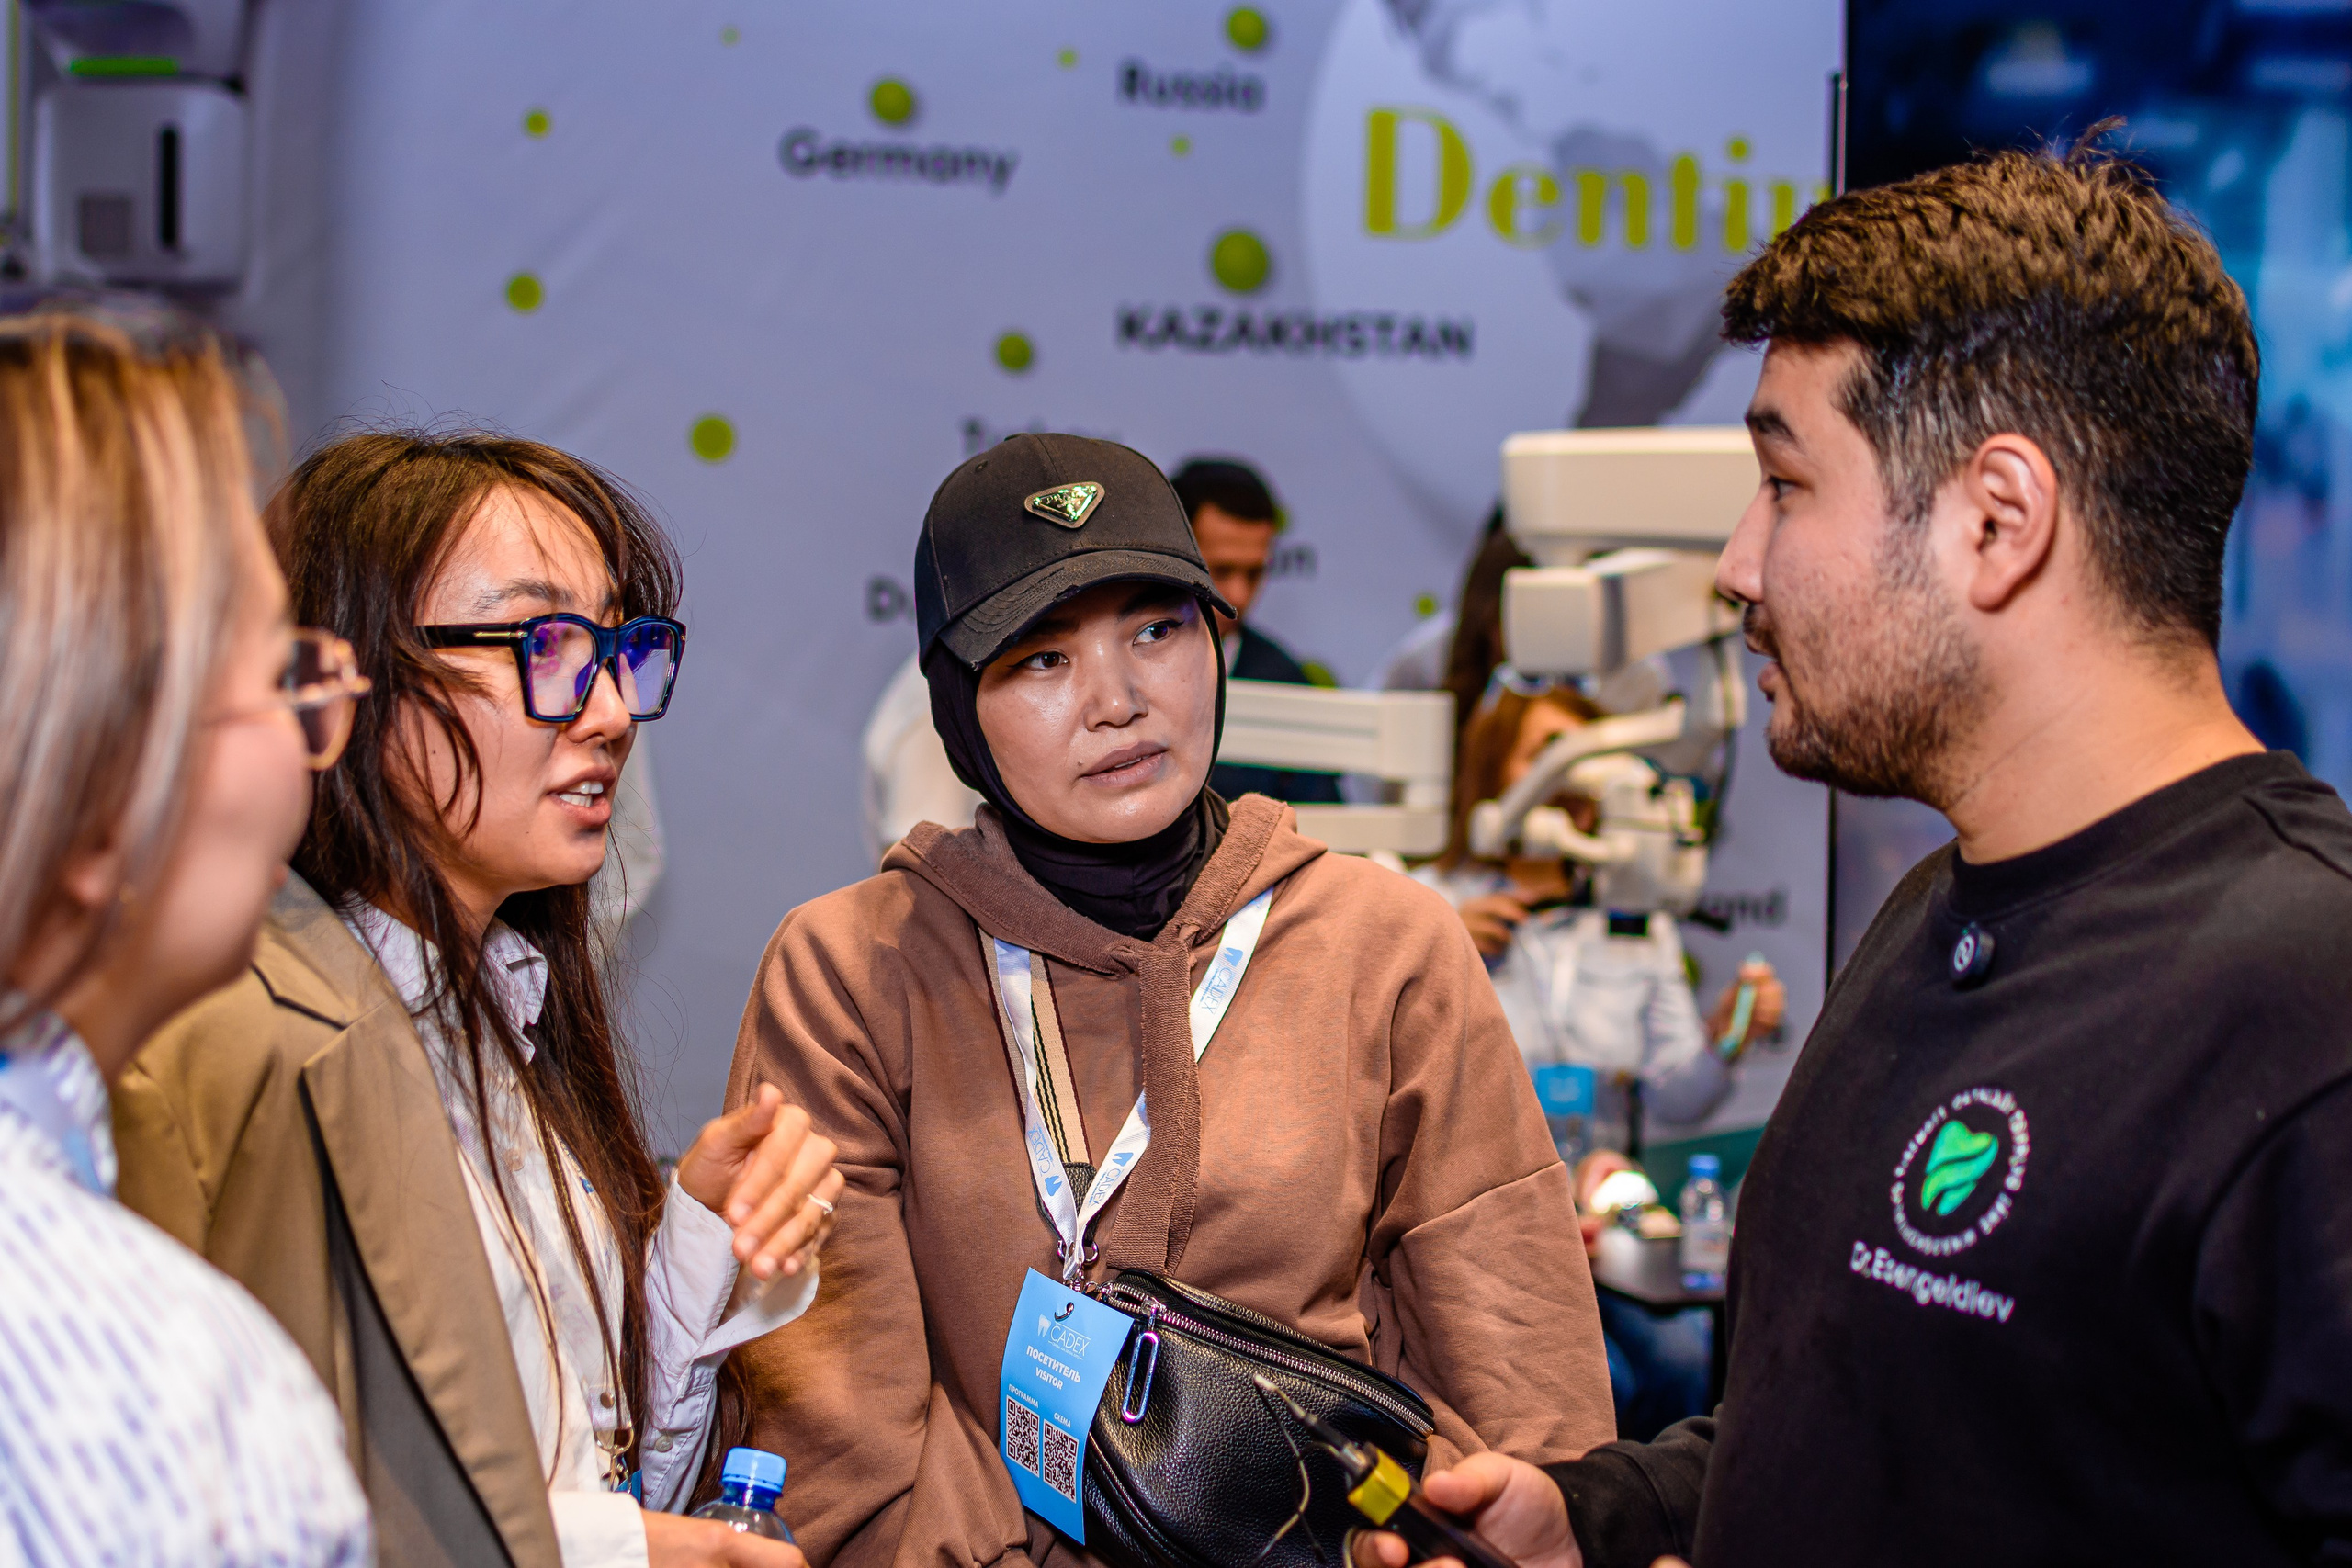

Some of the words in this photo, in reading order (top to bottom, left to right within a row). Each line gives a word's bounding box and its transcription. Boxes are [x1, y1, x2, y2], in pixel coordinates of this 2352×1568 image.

[1117, 58, 1266, 112] Russia
[779, 126, 1017, 194] Germany
[1117, 305, 1472, 359] KAZAKHSTAN
[1203, 967, 1232, 1014] CADEX
[1050, 1325, 1090, 1357] CADEX
[1026, 1345, 1081, 1383] ПОСЕТИТЕЛЬ
[1035, 1366, 1063, 1390] VISITOR
[1008, 1383, 1039, 1408] ПРОГРАММА
[1053, 1412, 1071, 1428] СХЕМА
